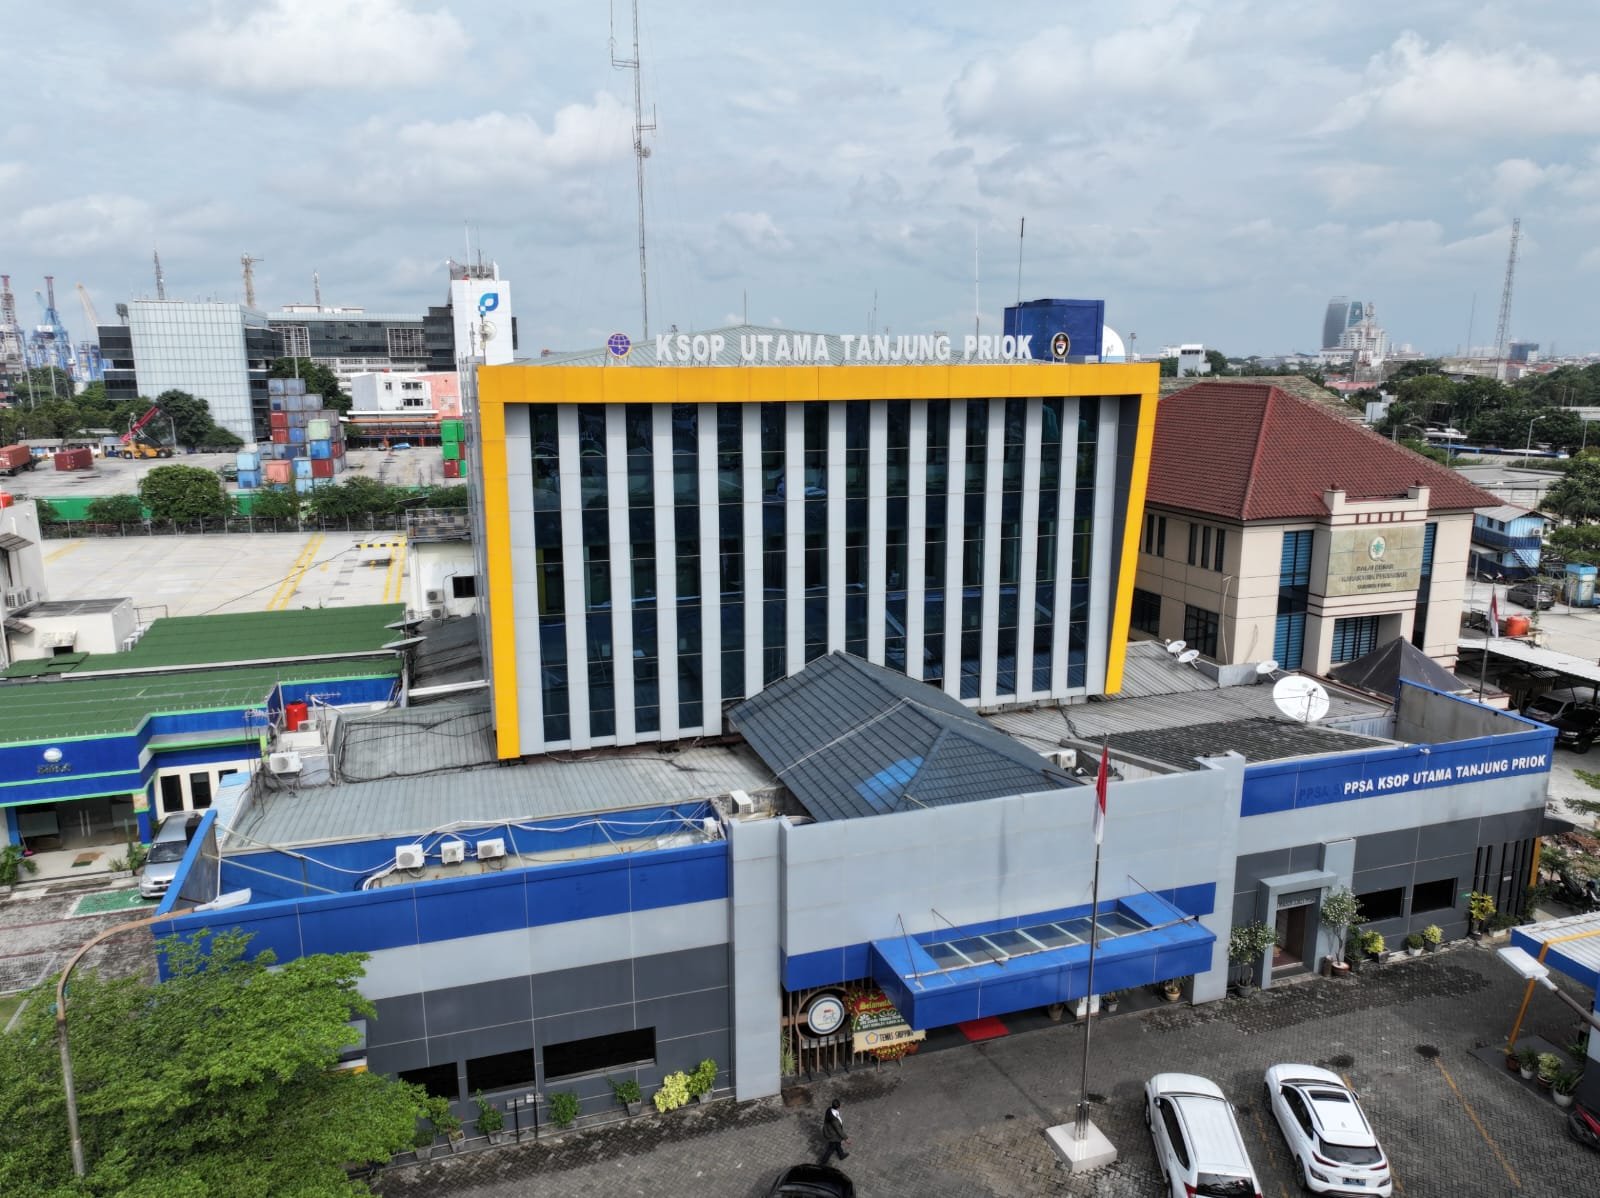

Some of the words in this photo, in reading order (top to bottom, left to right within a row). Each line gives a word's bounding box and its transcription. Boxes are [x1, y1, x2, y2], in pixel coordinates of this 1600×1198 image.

[656, 334, 725, 362] KSOP
[741, 334, 830, 361] UTAMA
[840, 334, 951, 361] TANJUNG
[964, 334, 1033, 360] PRIOK
[1344, 779, 1373, 795] PPSA
[1378, 773, 1410, 791] KSOP
[1413, 767, 1452, 785] UTAMA
[1456, 760, 1509, 778] TANJUNG
[1512, 755, 1546, 769] PRIOK
